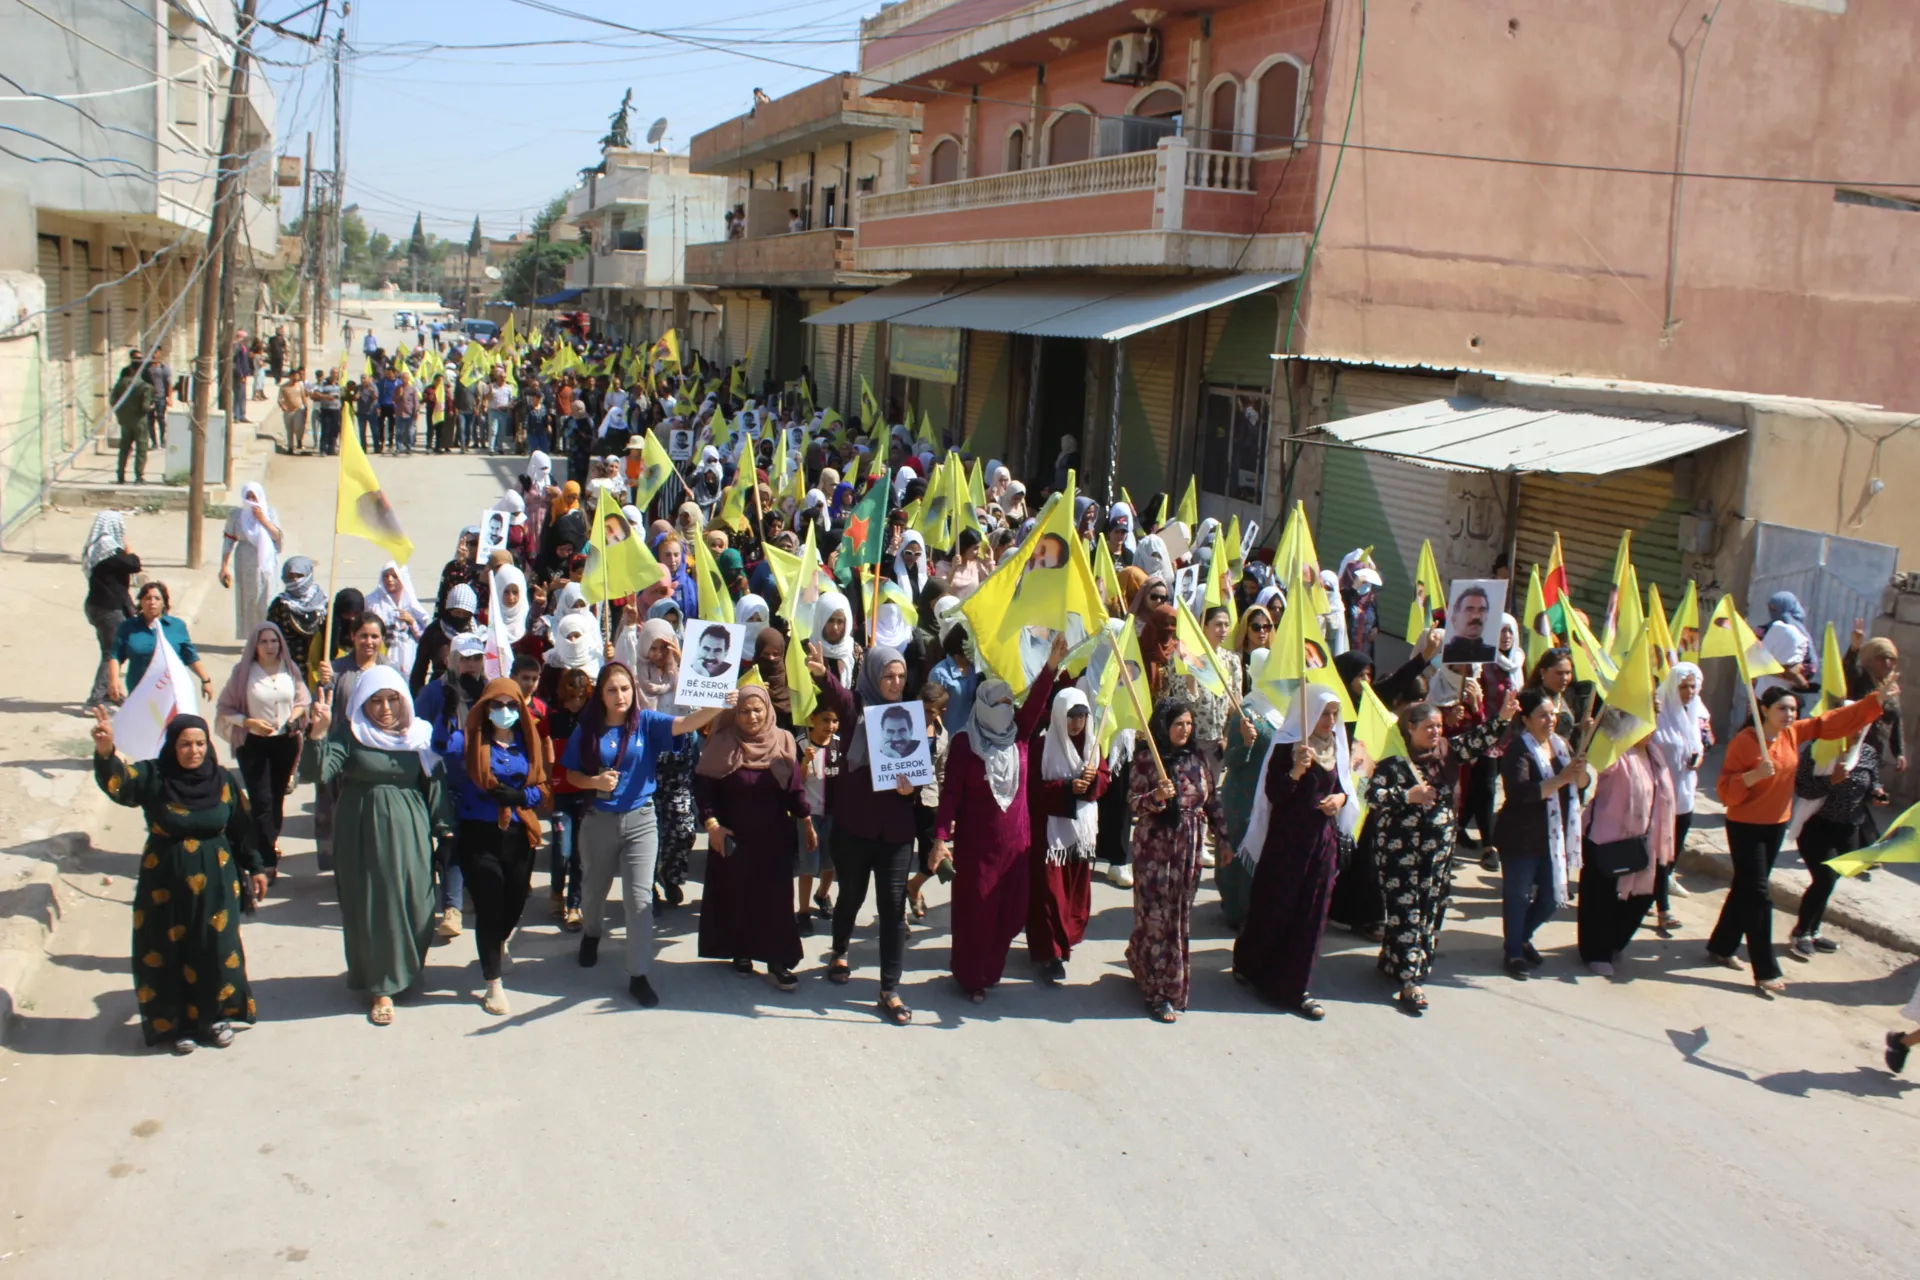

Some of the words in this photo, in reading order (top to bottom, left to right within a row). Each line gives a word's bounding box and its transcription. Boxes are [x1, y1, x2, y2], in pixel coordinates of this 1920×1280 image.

[686, 679, 699, 688] BÊ
[700, 680, 730, 690] SEROK
[680, 689, 705, 698] JIYAN
[880, 762, 893, 772] BÊ
[895, 759, 925, 770] SEROK
[877, 772, 902, 783] JIYA
